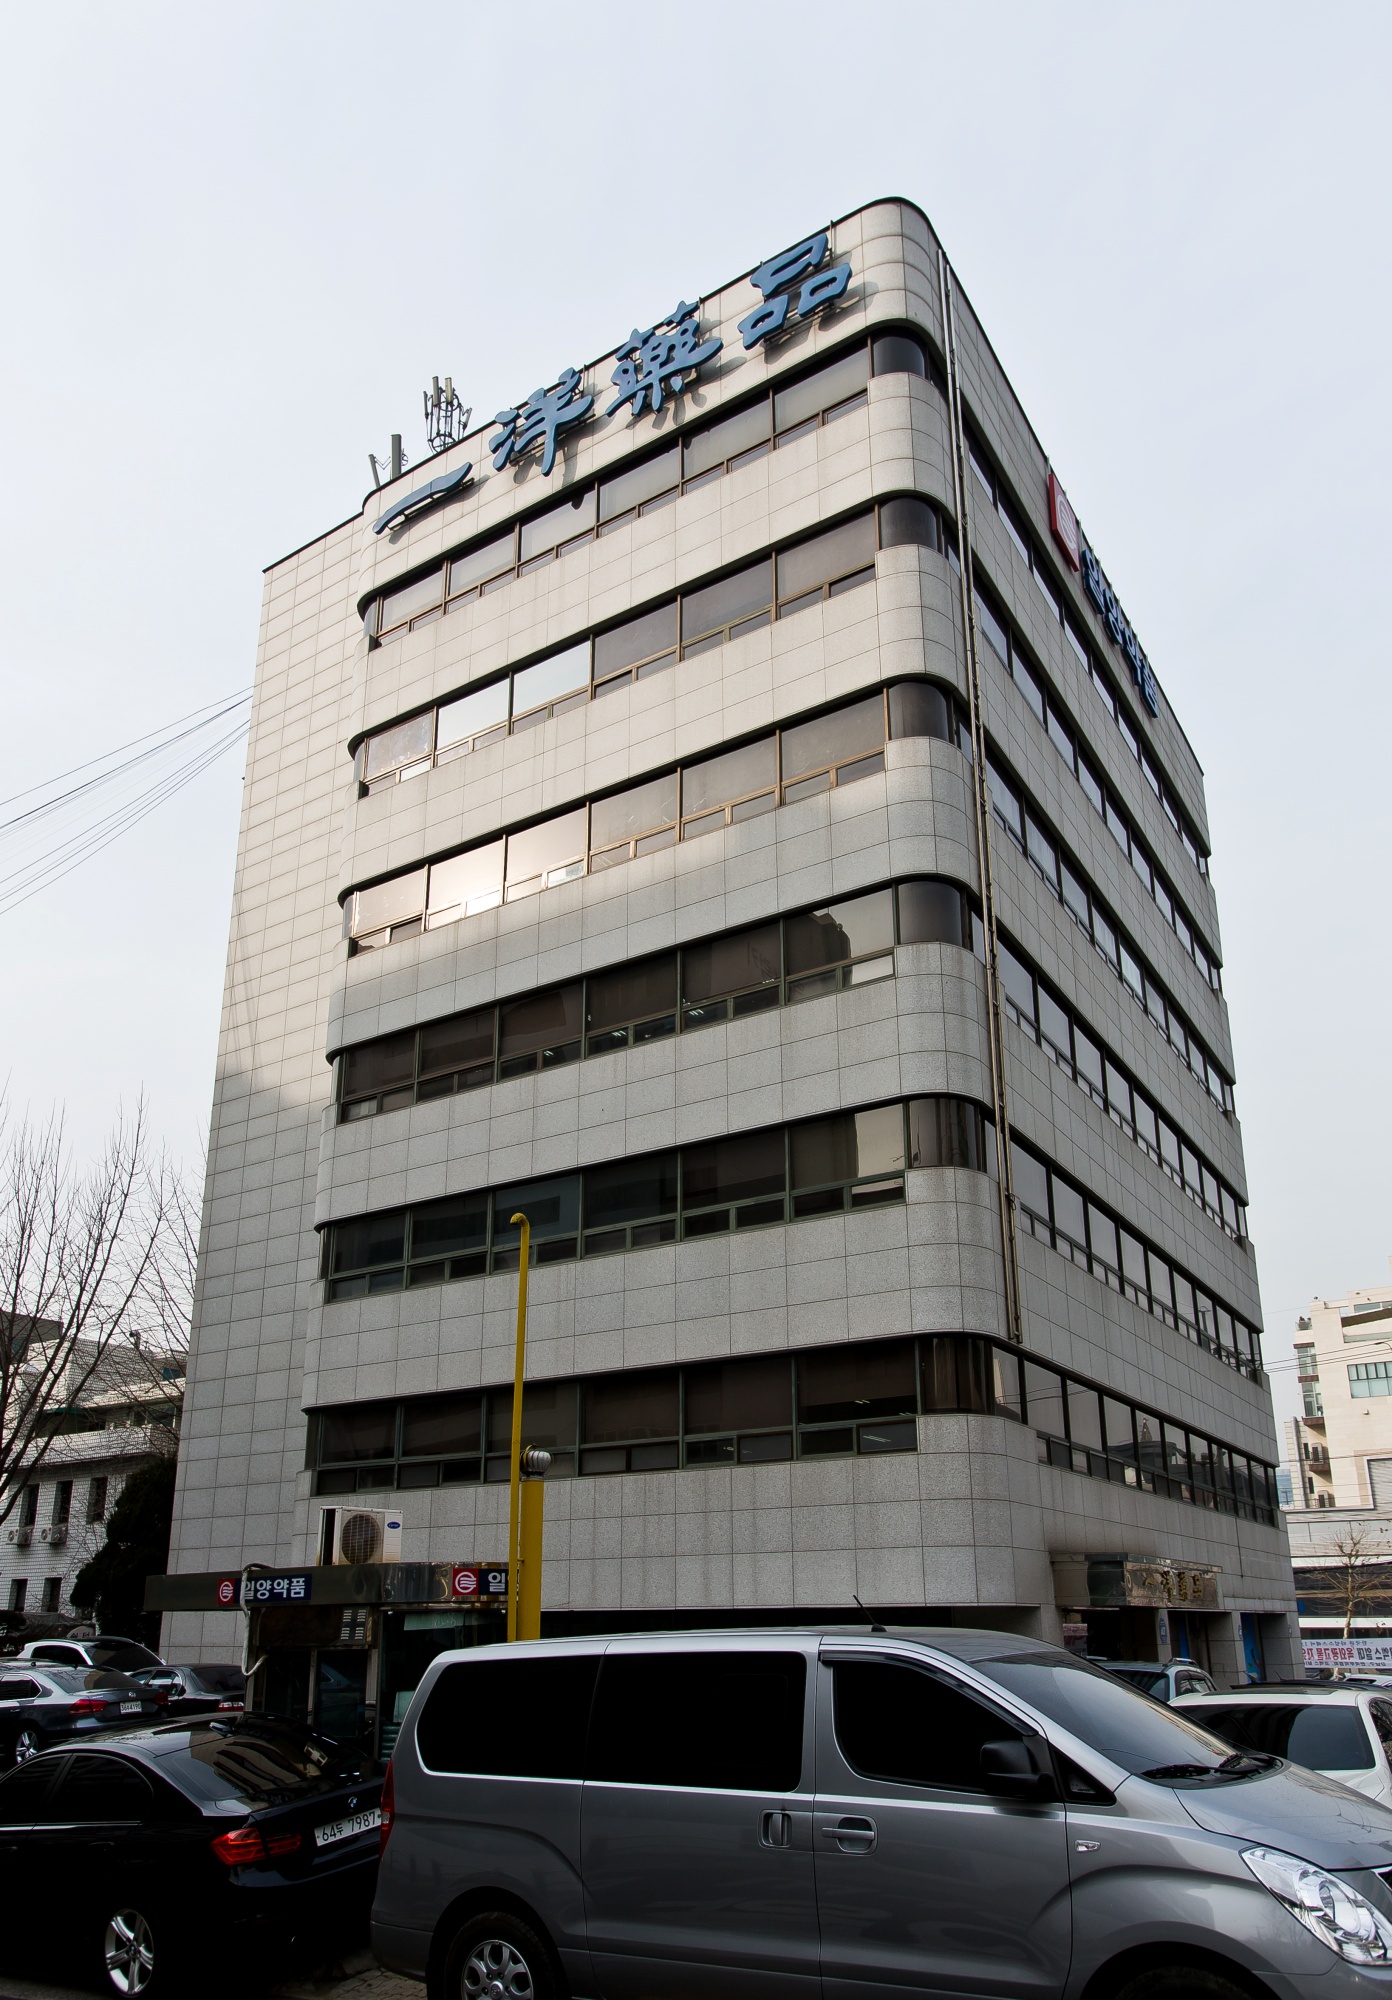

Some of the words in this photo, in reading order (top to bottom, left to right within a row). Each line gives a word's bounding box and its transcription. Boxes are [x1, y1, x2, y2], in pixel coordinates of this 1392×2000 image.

[373, 233, 852, 535] 一洋藥品
[1082, 549, 1159, 718] 일양약품
[244, 1578, 305, 1600] 일양약품
[322, 1822, 344, 1842] 64두
[348, 1811, 376, 1832] 7987
